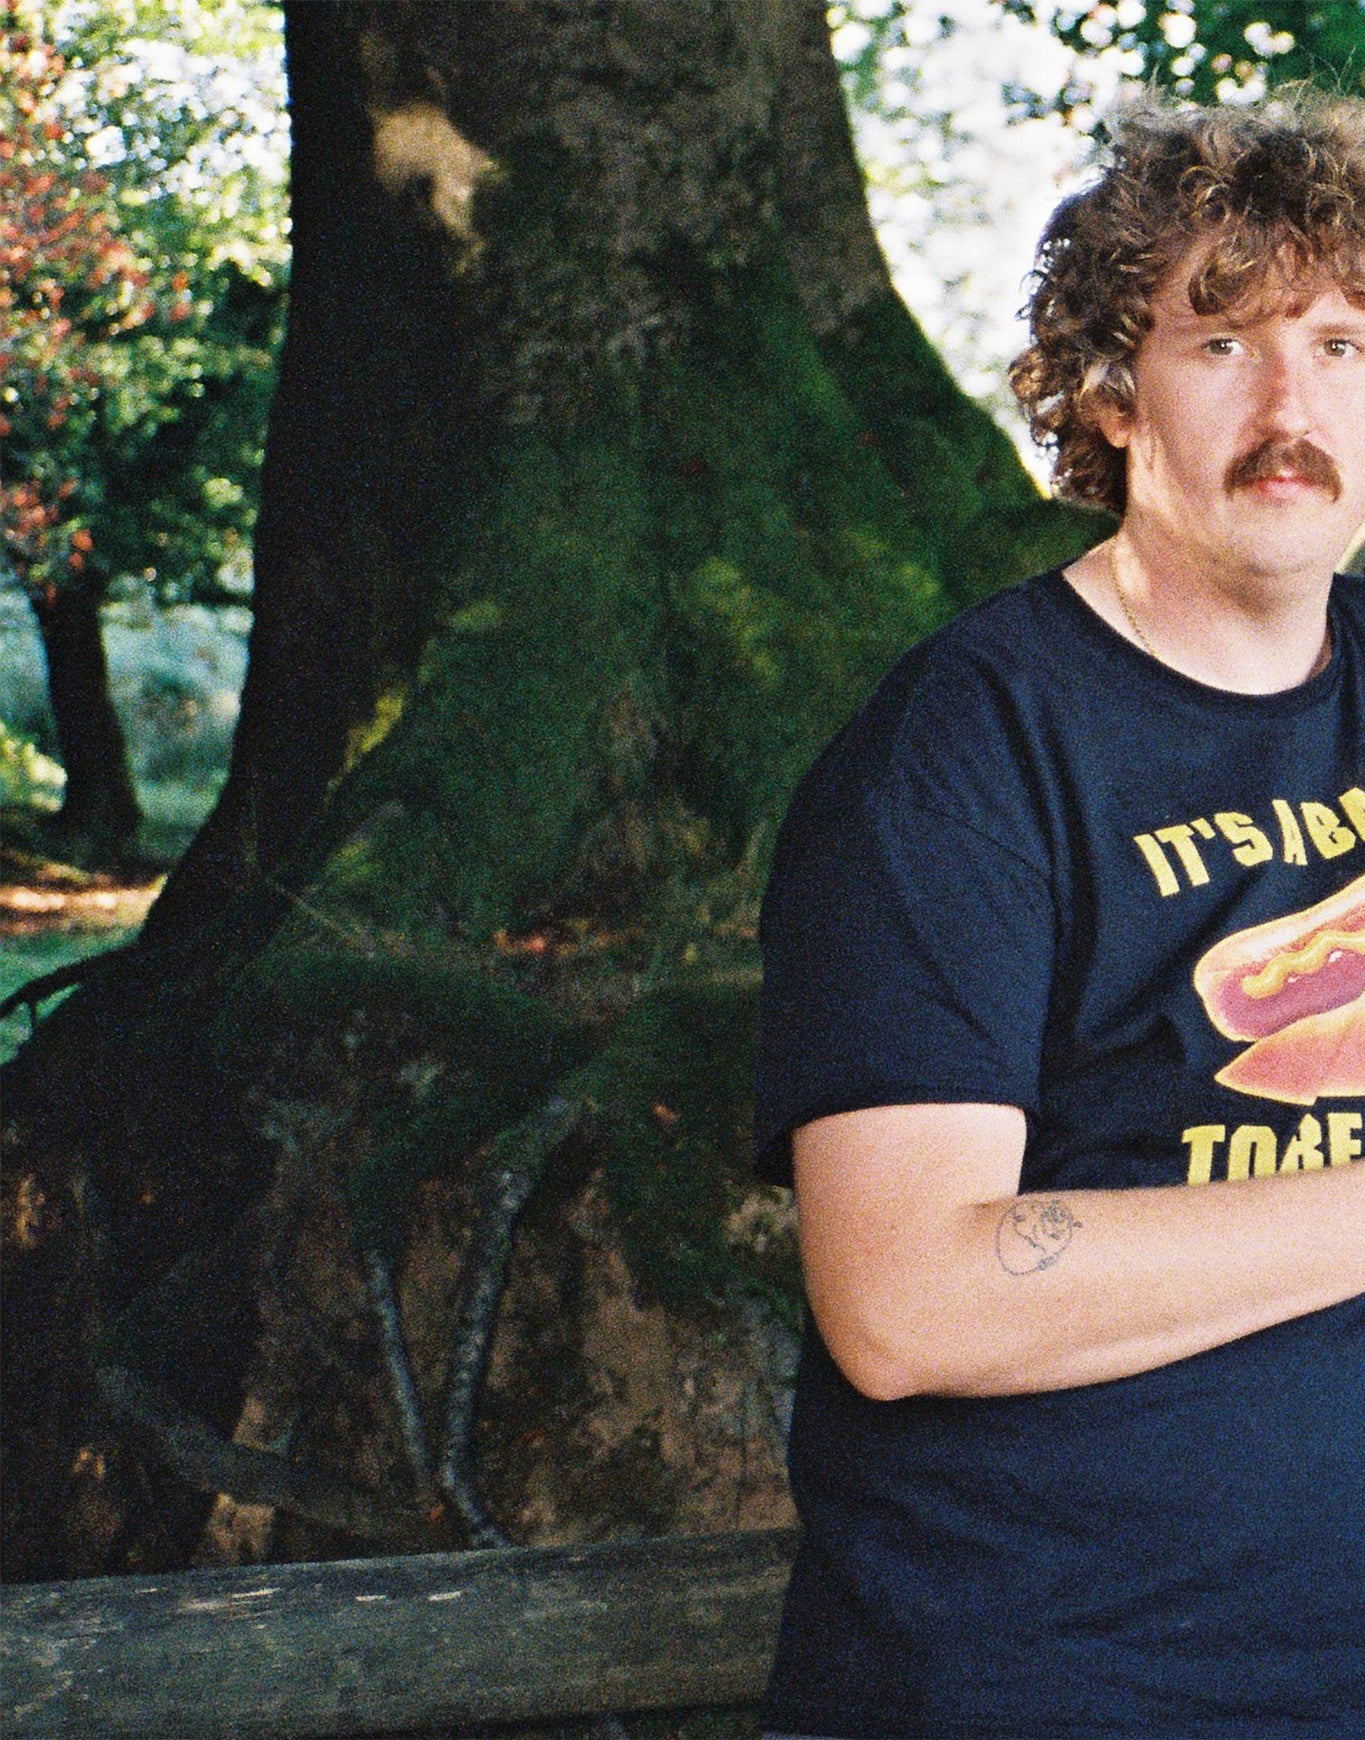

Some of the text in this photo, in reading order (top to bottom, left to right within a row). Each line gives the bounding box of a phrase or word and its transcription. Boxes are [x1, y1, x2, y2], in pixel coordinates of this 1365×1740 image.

[1133, 811, 1273, 897] IT'S
[1272, 799, 1308, 866] A
[1181, 1124, 1278, 1186] TO
[1278, 1112, 1363, 1175] BE
